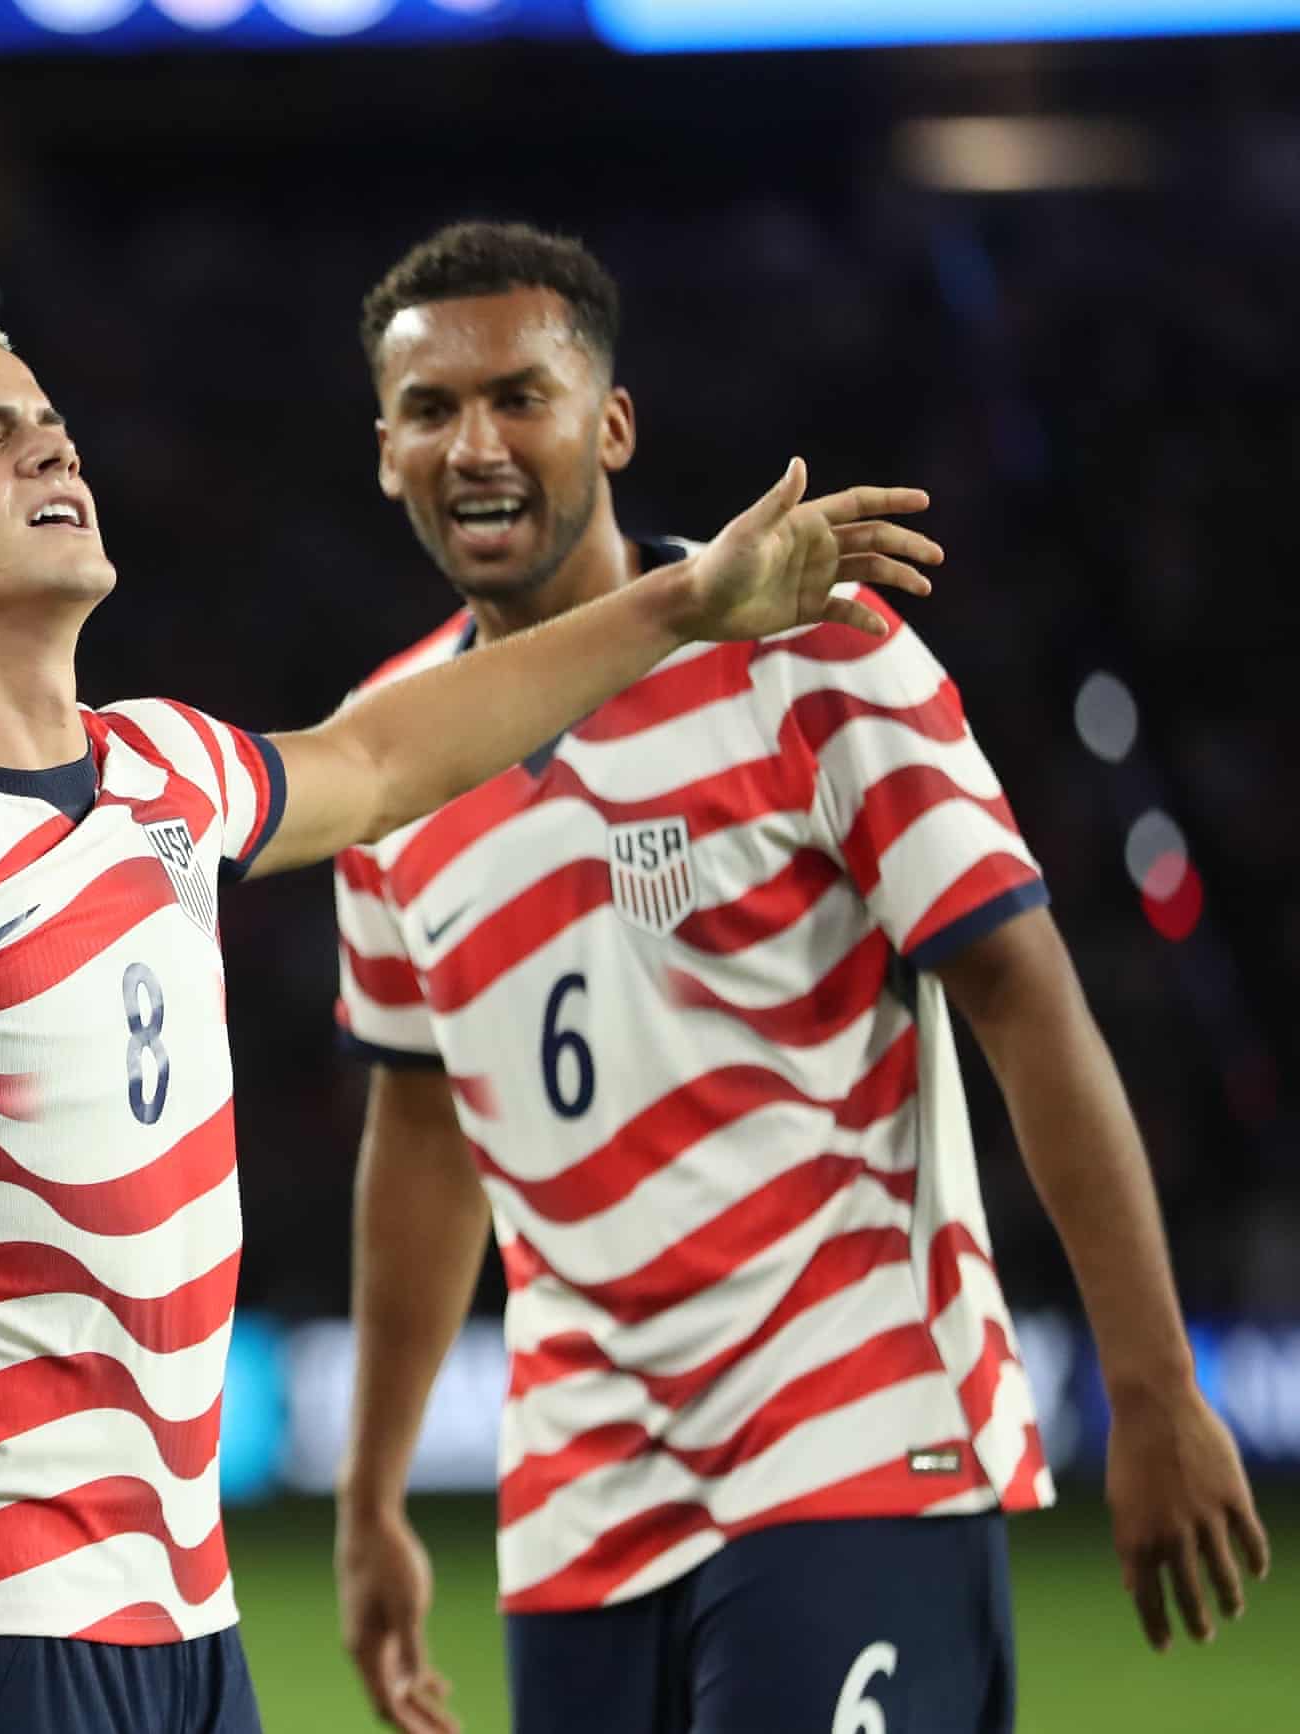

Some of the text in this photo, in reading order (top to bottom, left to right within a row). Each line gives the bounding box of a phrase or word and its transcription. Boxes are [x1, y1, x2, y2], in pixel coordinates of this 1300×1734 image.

[150, 825, 193, 870] USA
[615, 827, 682, 870] USA
[123, 962, 170, 1125] 8
[541, 973, 596, 1121] 6
[831, 1641, 898, 1734] 6
